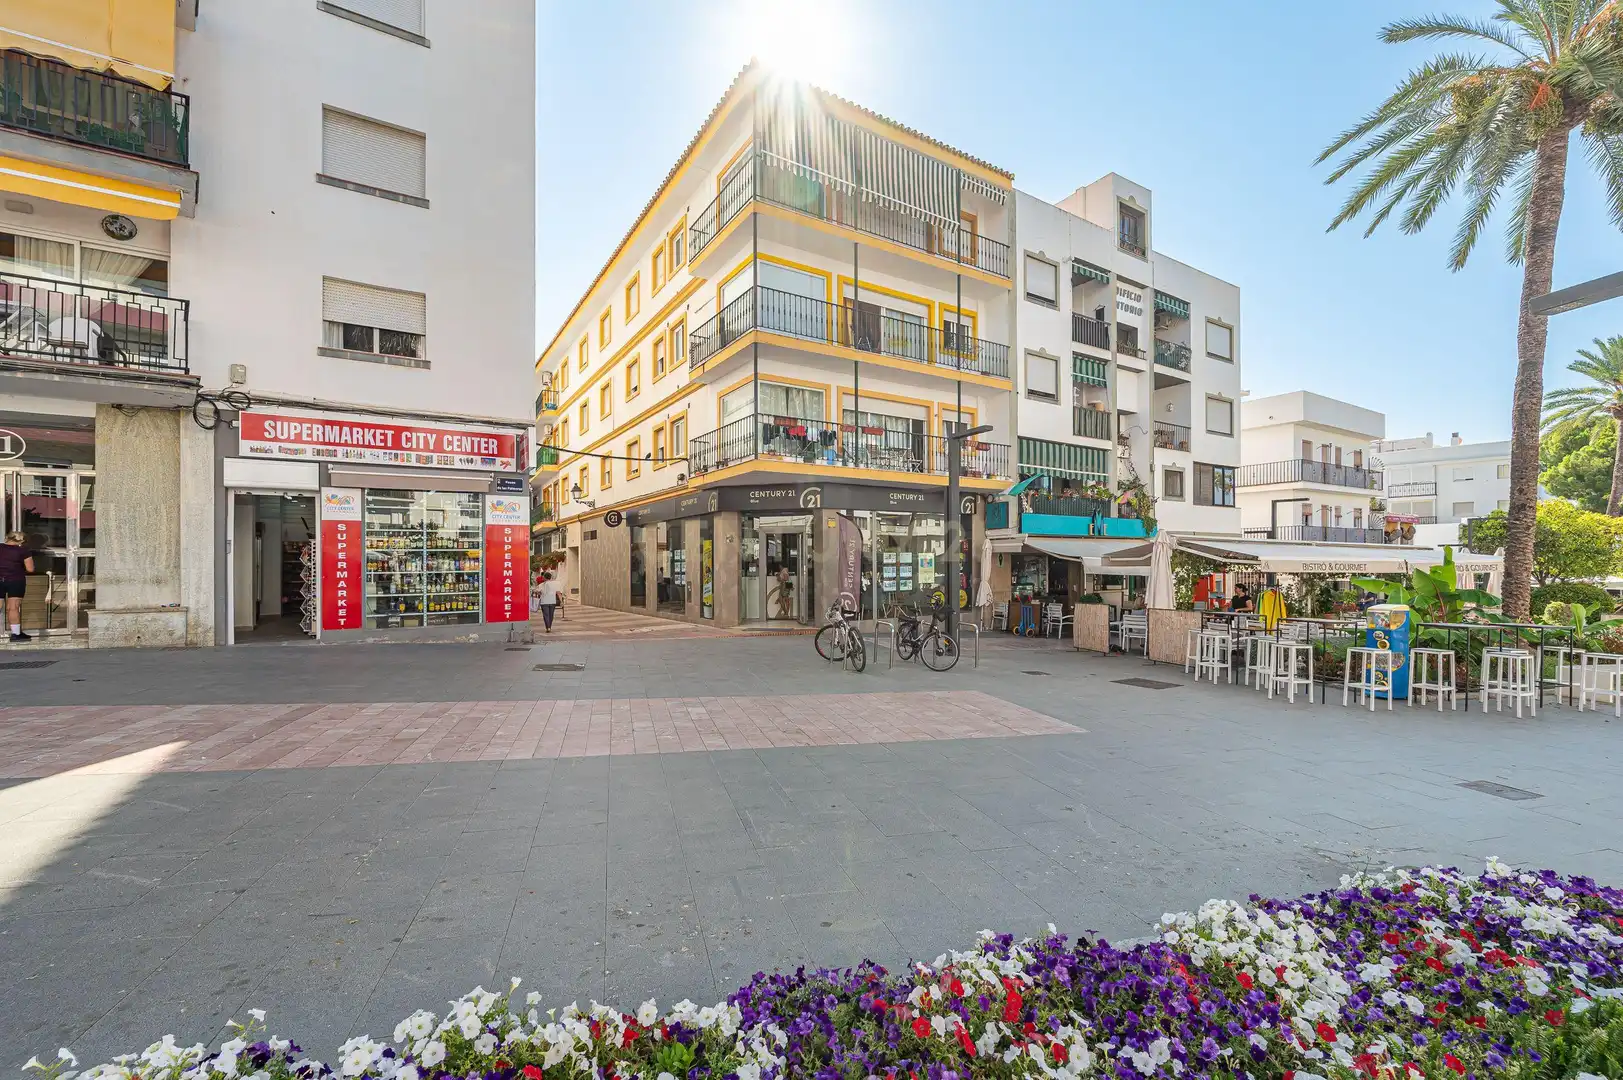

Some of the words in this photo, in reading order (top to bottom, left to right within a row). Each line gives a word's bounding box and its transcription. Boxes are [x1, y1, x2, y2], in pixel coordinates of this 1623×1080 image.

[263, 419, 395, 447] SUPERMARKET
[401, 431, 437, 450] CITY
[443, 434, 498, 455] CENTER
[749, 490, 786, 498] CENTURY
[787, 489, 796, 497] 21
[889, 492, 918, 501] CENTURY
[1328, 563, 1334, 571] &
[1334, 563, 1368, 572] GOURMET
[1470, 564, 1499, 572] GOURMET
[336, 523, 348, 626] SUPERMARKET
[503, 527, 513, 619] SUPERMARKET
